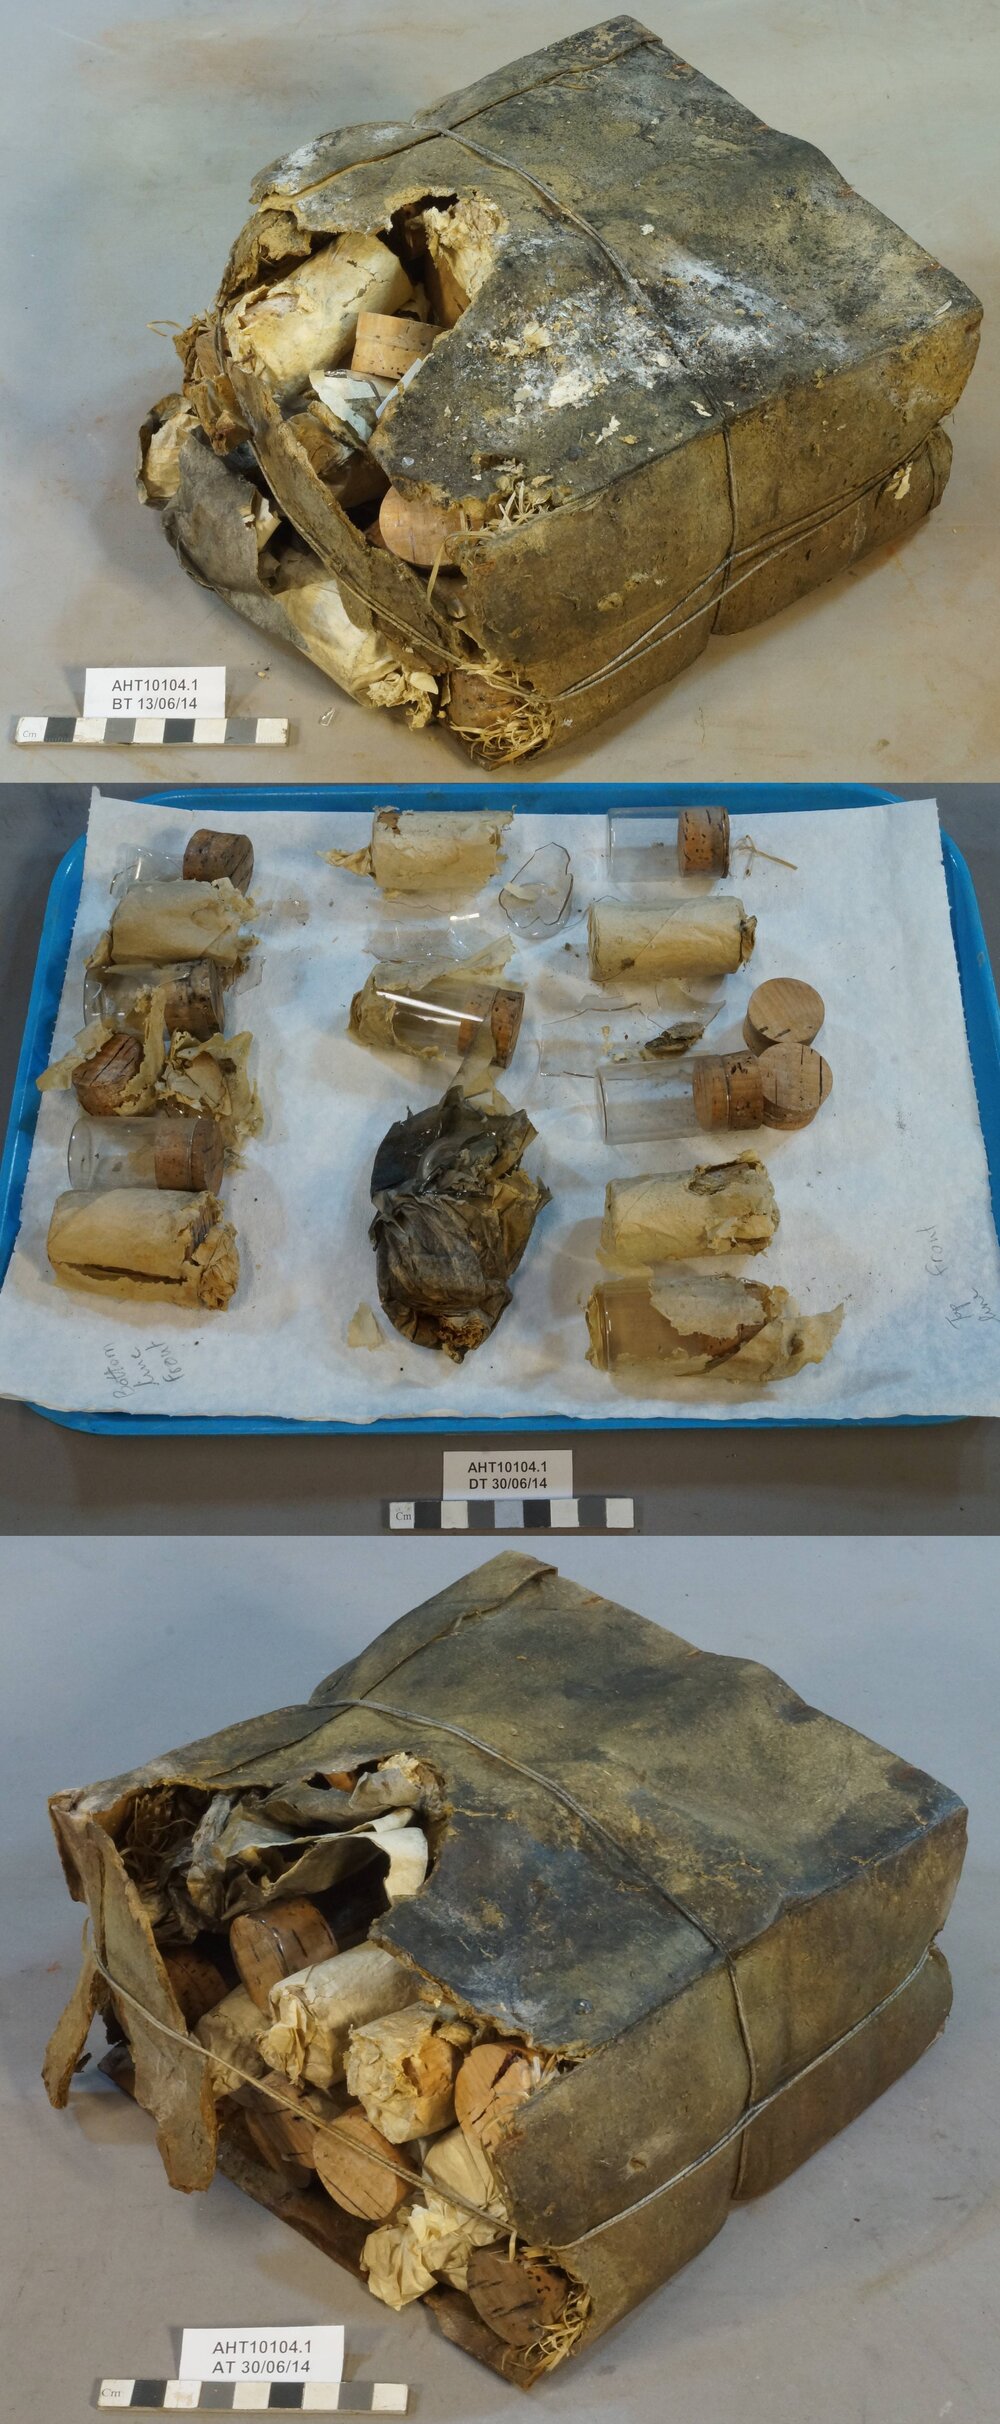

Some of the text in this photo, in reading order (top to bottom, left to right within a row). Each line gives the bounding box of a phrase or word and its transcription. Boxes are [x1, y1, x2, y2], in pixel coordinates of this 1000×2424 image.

[112, 679, 198, 692] AHT10104.1
[112, 697, 198, 710] BT 13/06/14
[103, 1342, 135, 1399] Bottom
[467, 1461, 548, 1474] AHT10104.1
[469, 1477, 548, 1490] DT 30/06/14
[395, 1511, 412, 1522] Cm
[212, 2340, 312, 2354] AHT10104.1
[212, 2360, 311, 2374] AT 30/06/14
[101, 2388, 121, 2398] Cm
